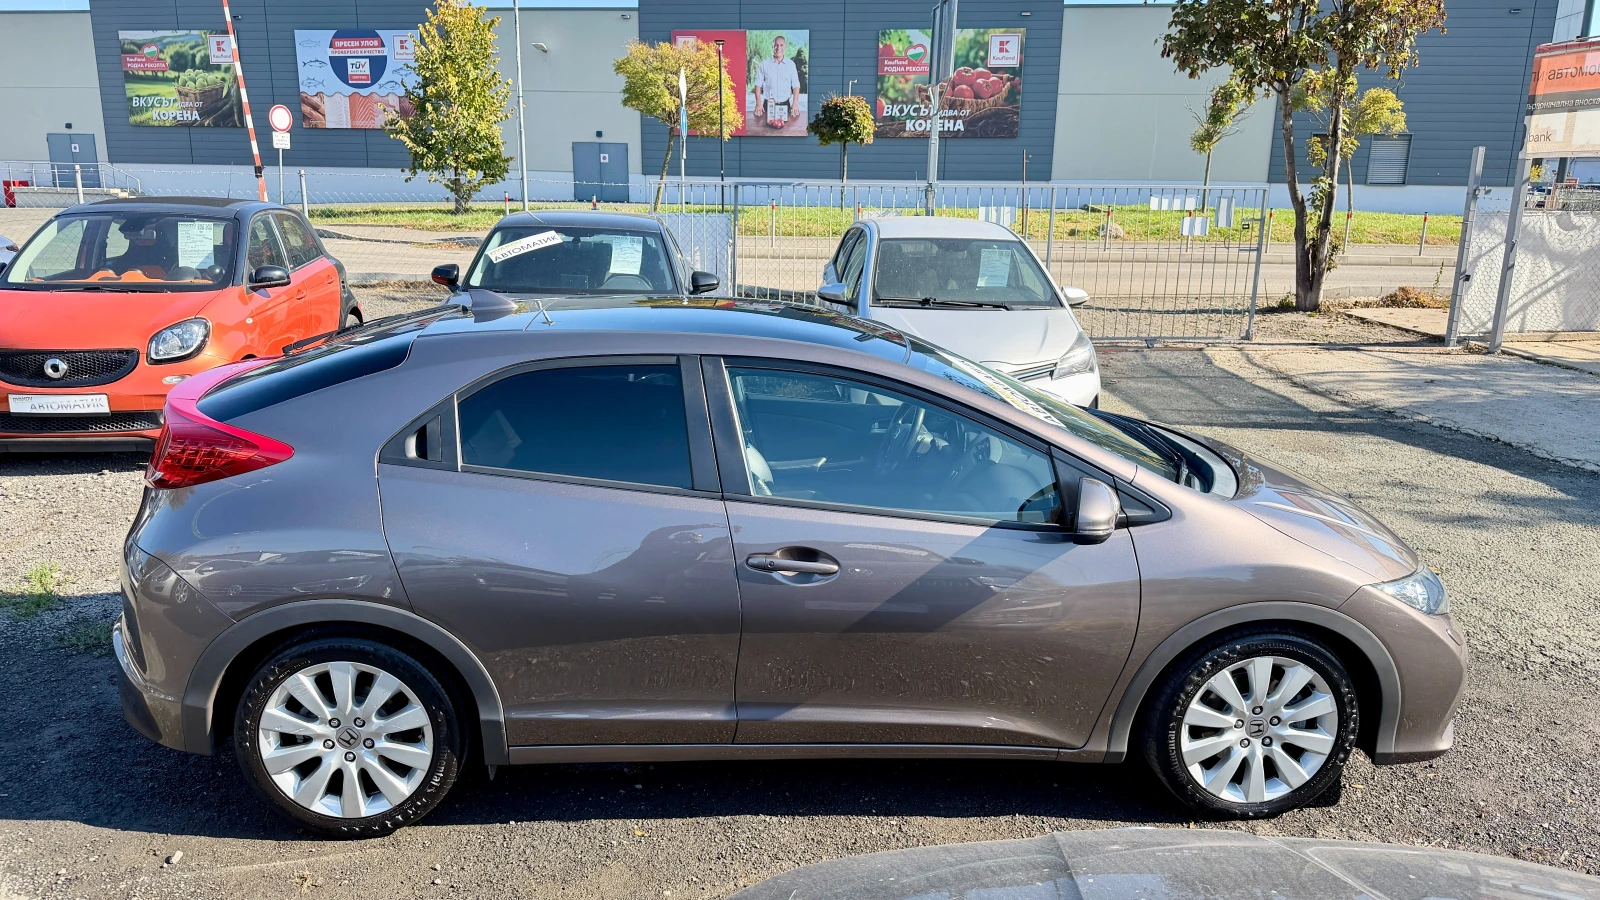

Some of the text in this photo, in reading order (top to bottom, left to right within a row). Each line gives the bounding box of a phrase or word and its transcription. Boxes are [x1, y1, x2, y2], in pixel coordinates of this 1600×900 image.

[335, 40, 359, 48] ПРЕСЕН
[350, 61, 366, 69] TÜV
[132, 96, 176, 107] ВКУСЪТ
[152, 110, 201, 121] КОРЕНА
[494, 235, 559, 262] АВТОМАТИК
